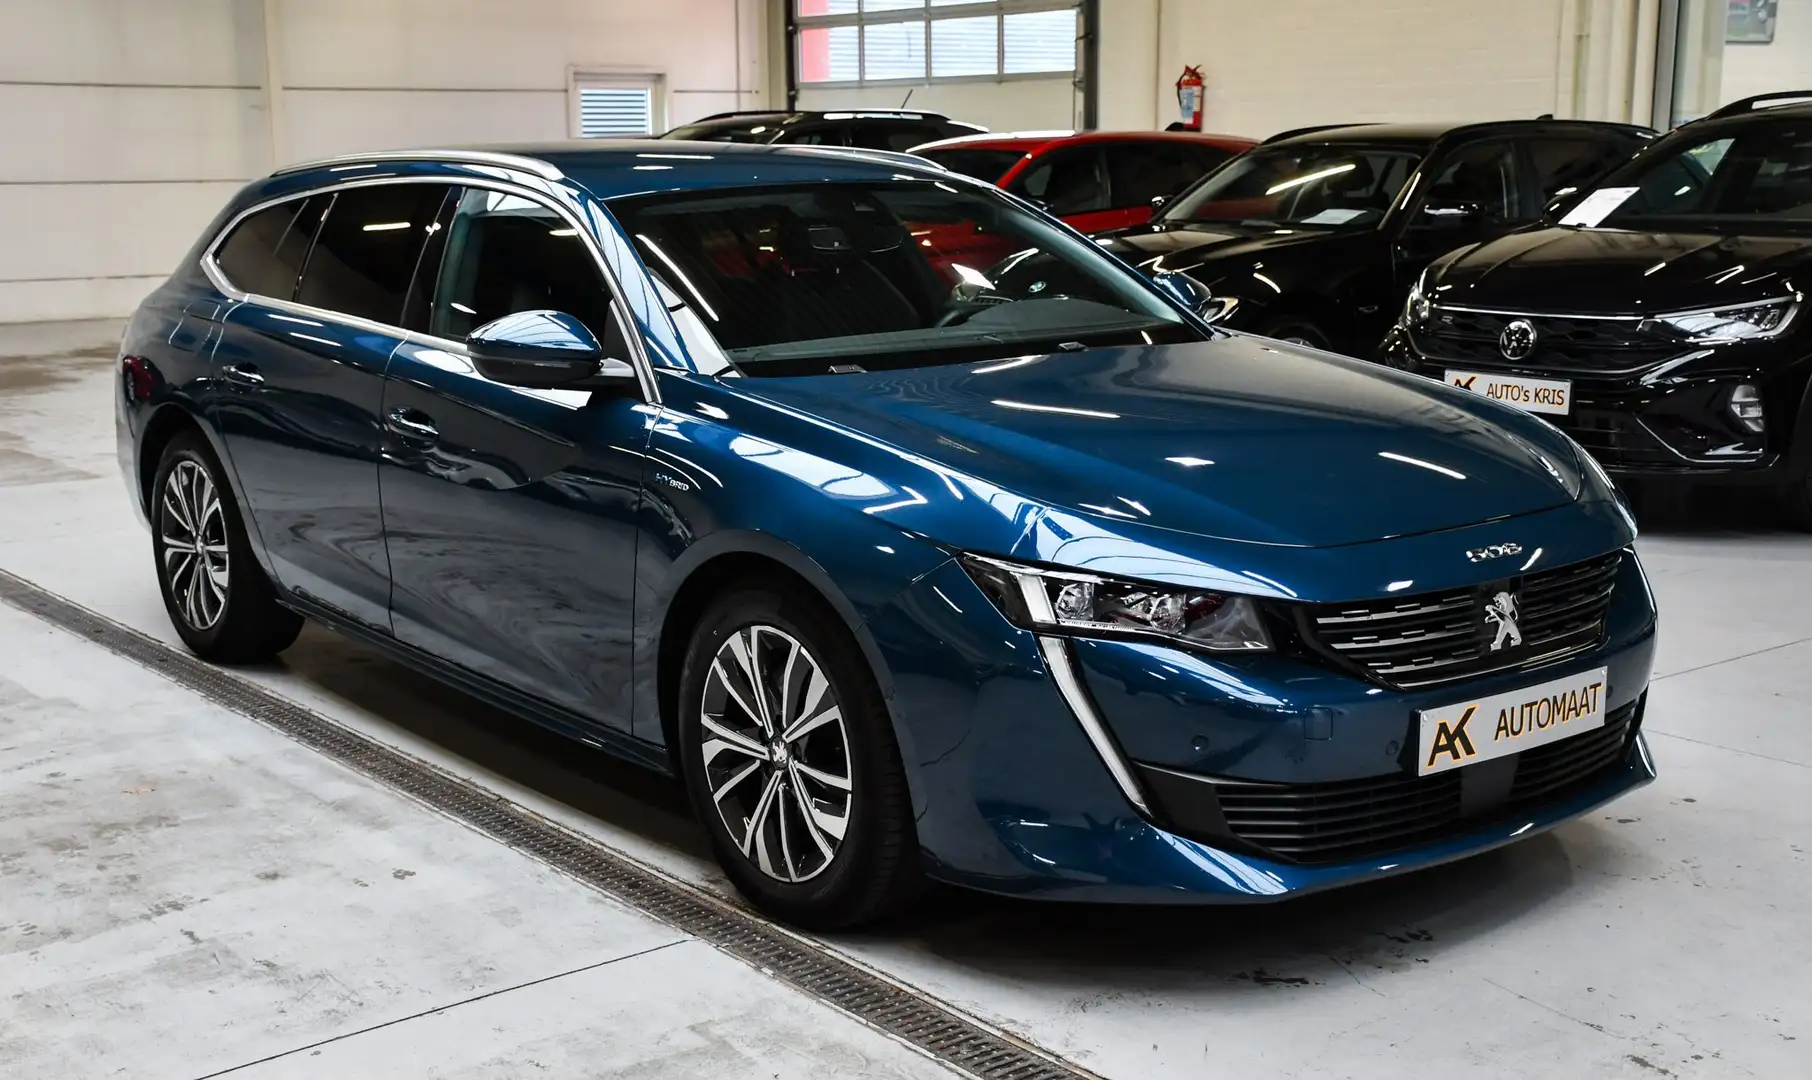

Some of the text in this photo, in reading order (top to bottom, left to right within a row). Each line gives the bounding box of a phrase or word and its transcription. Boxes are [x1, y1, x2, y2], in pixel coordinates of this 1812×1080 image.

[1486, 383, 1530, 402] AUTO's
[1533, 387, 1565, 406] KRIS
[655, 472, 690, 492] HYBRID
[1465, 542, 1523, 563] 508
[1427, 682, 1602, 768] AK AUTOMAAT
